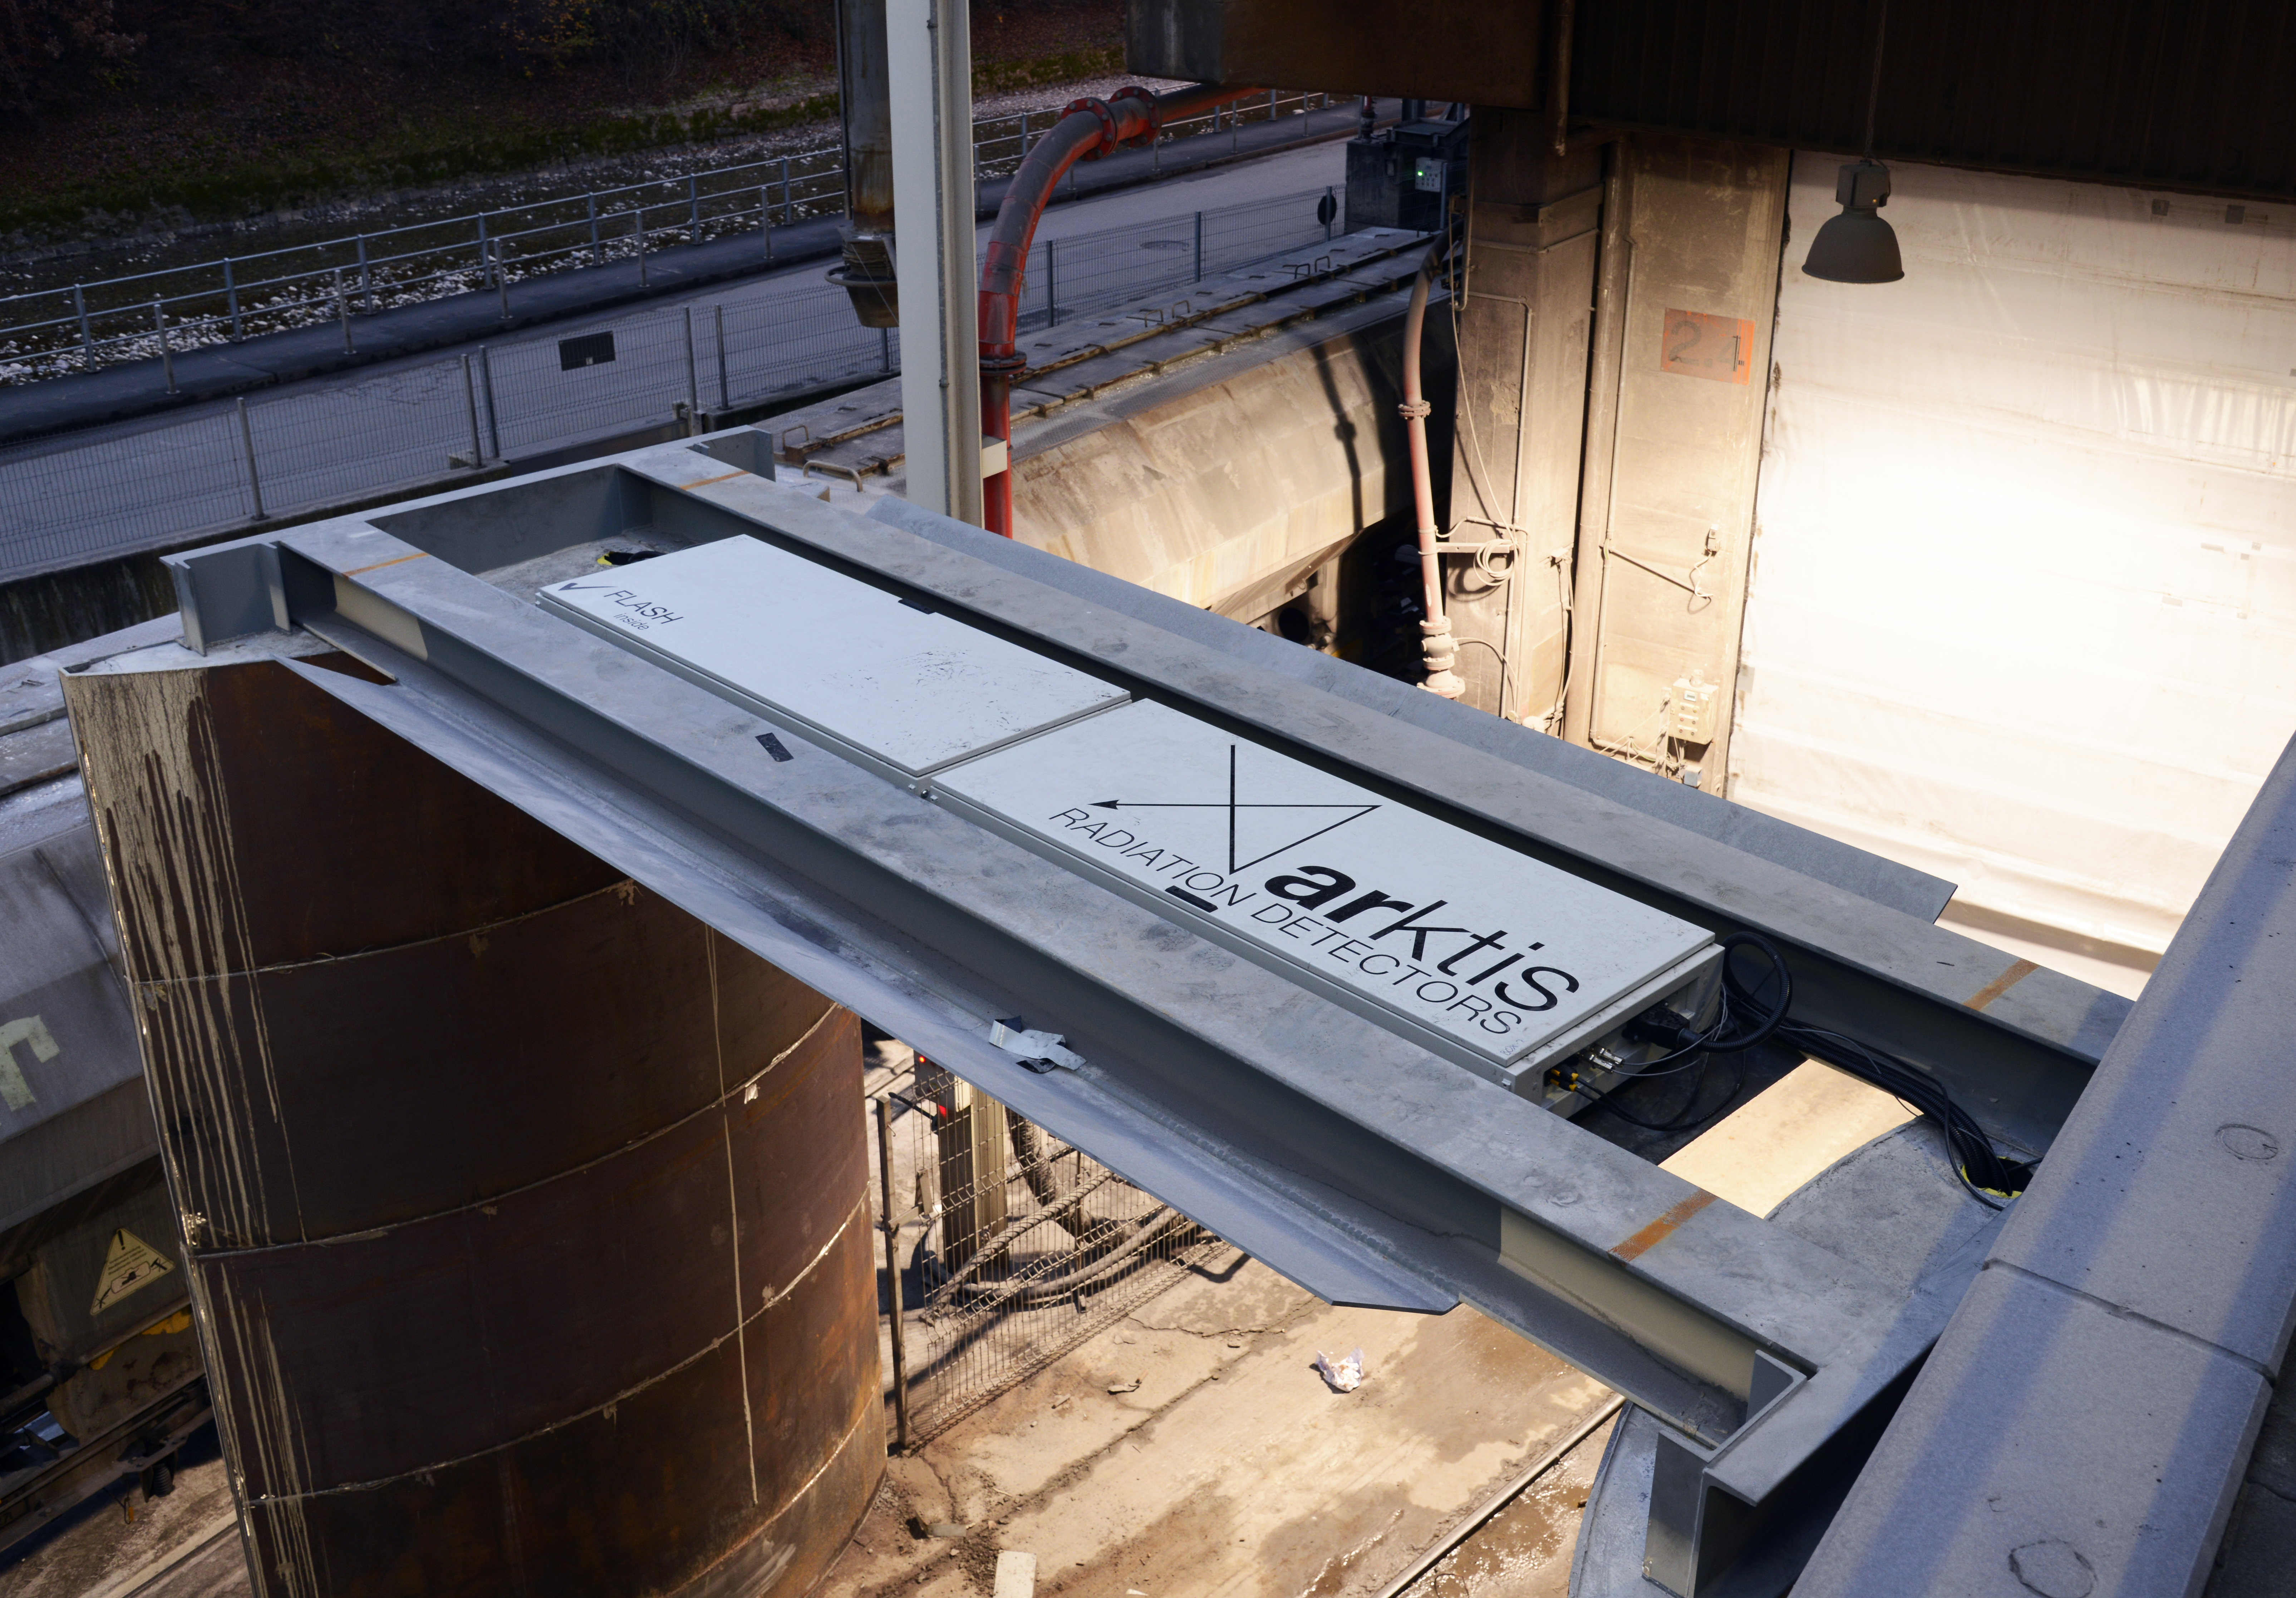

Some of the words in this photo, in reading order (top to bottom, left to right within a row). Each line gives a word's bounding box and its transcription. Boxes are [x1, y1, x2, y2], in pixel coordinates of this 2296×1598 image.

[604, 590, 684, 624] FLASH
[613, 612, 649, 630] inside
[1049, 808, 1257, 906] RADIATION
[1250, 903, 1521, 1035] DETECTORS
[1264, 865, 1579, 1011] arktis
[1500, 1044, 1519, 1055] BOX
